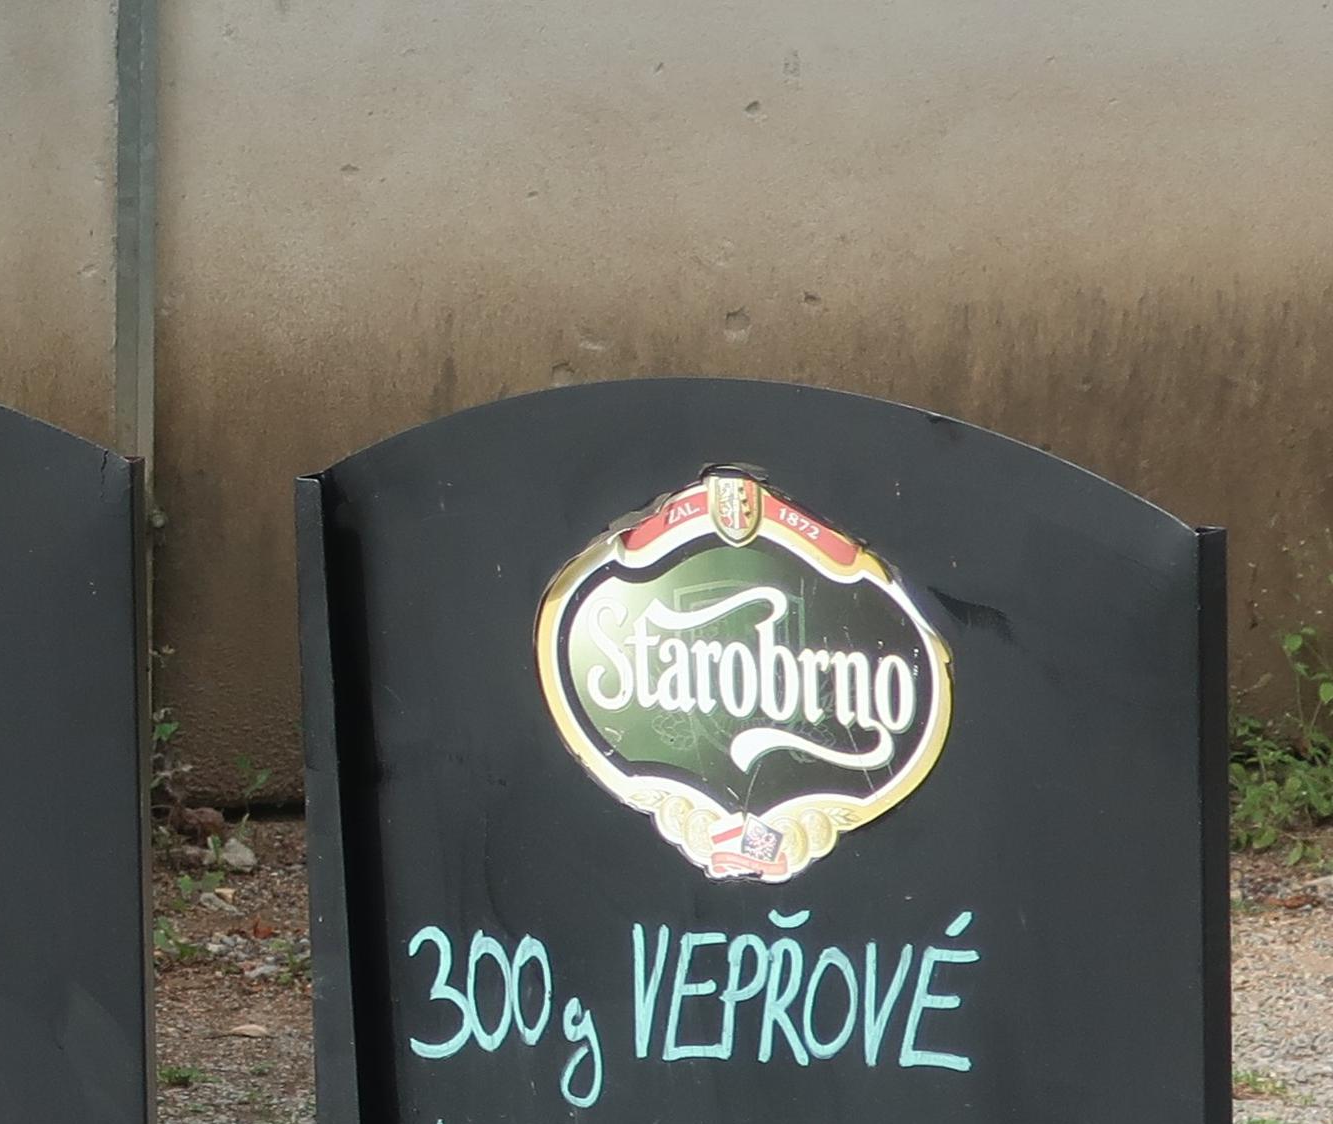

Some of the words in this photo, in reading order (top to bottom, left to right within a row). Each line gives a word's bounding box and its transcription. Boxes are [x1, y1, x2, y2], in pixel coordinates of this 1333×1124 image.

[779, 508, 821, 539] 1872
[587, 586, 916, 773] Starobrno
[408, 926, 602, 1107] 300g
[632, 909, 979, 1071] VEPŘOVÉ
